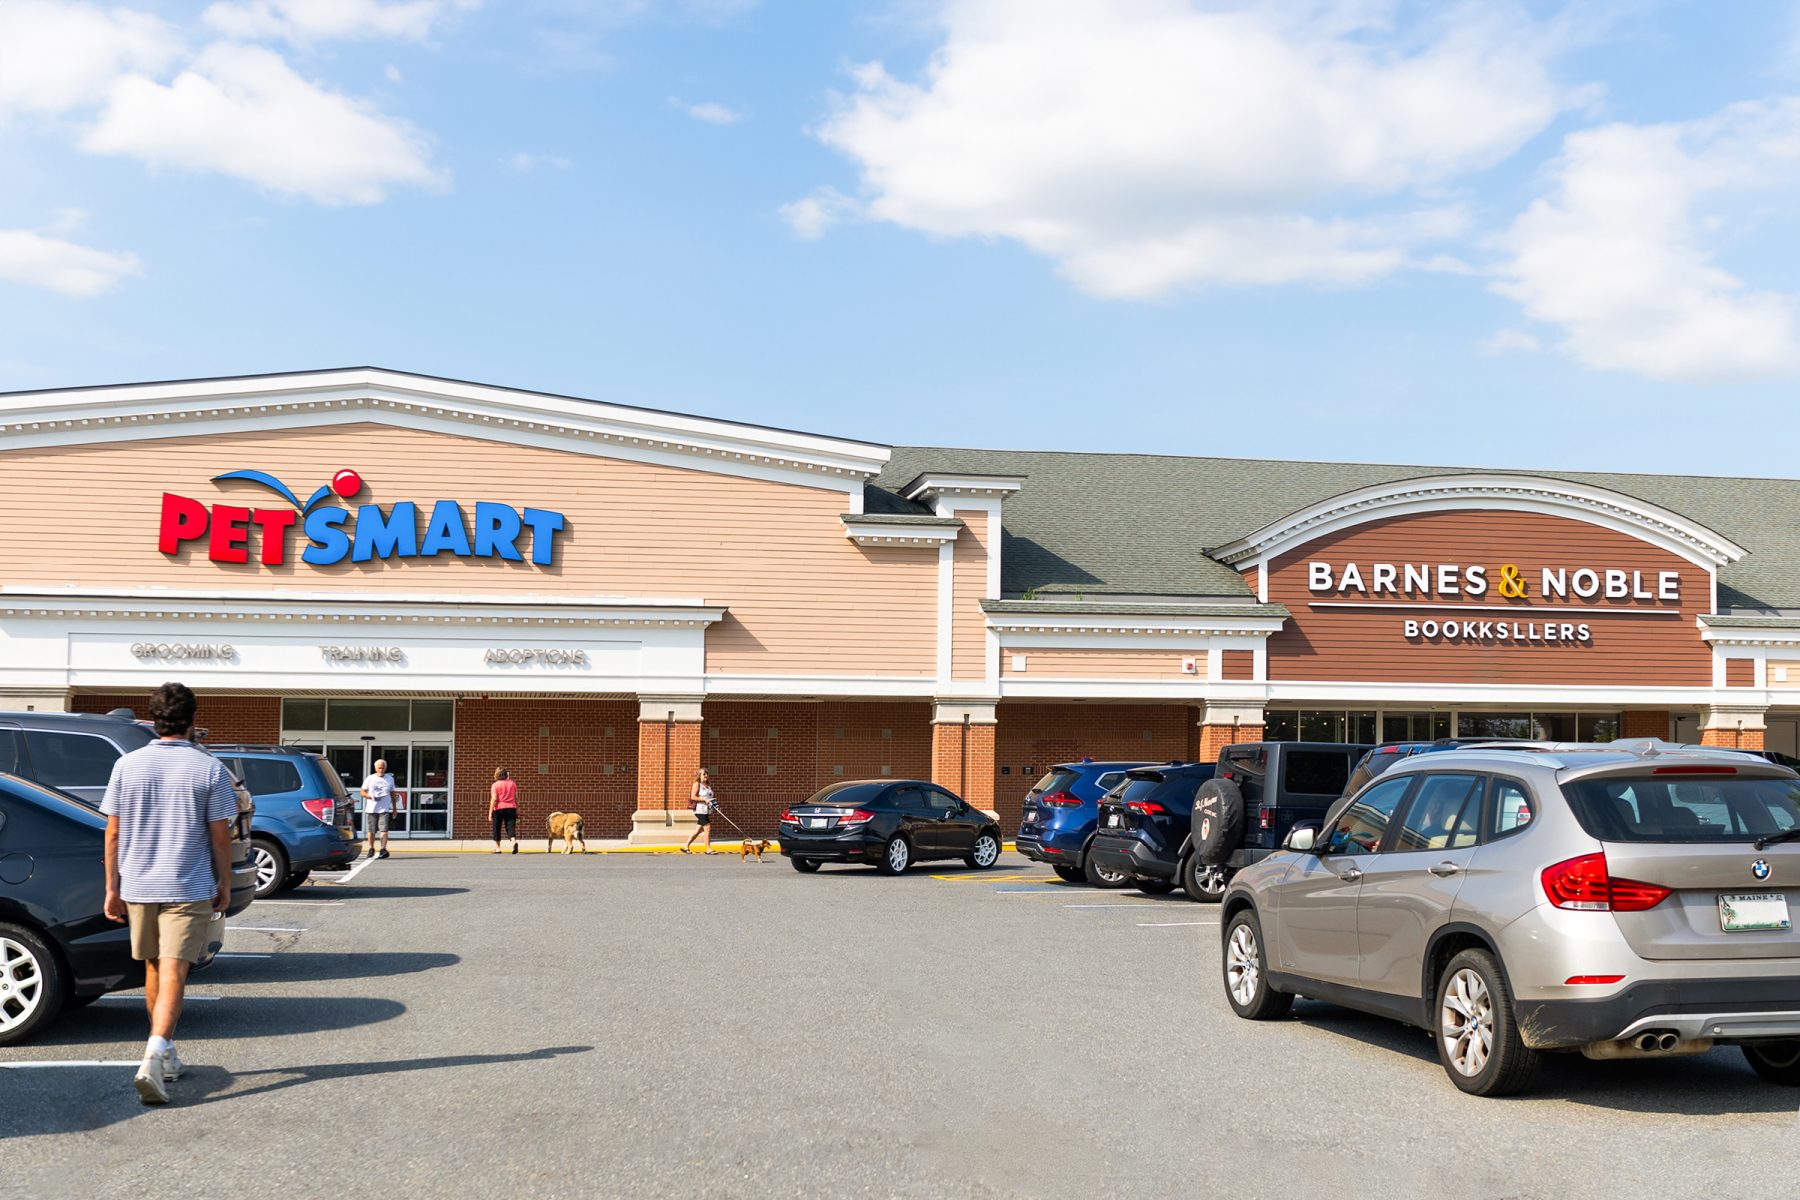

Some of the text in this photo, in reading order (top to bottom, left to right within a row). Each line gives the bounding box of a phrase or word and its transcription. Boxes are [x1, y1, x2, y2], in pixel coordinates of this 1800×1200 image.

[1308, 562, 1679, 600] BARNES & NOBLE
[130, 643, 233, 659] GROOMING
[318, 645, 401, 661] TRAINING
[483, 648, 586, 664] ADOPTIONS
